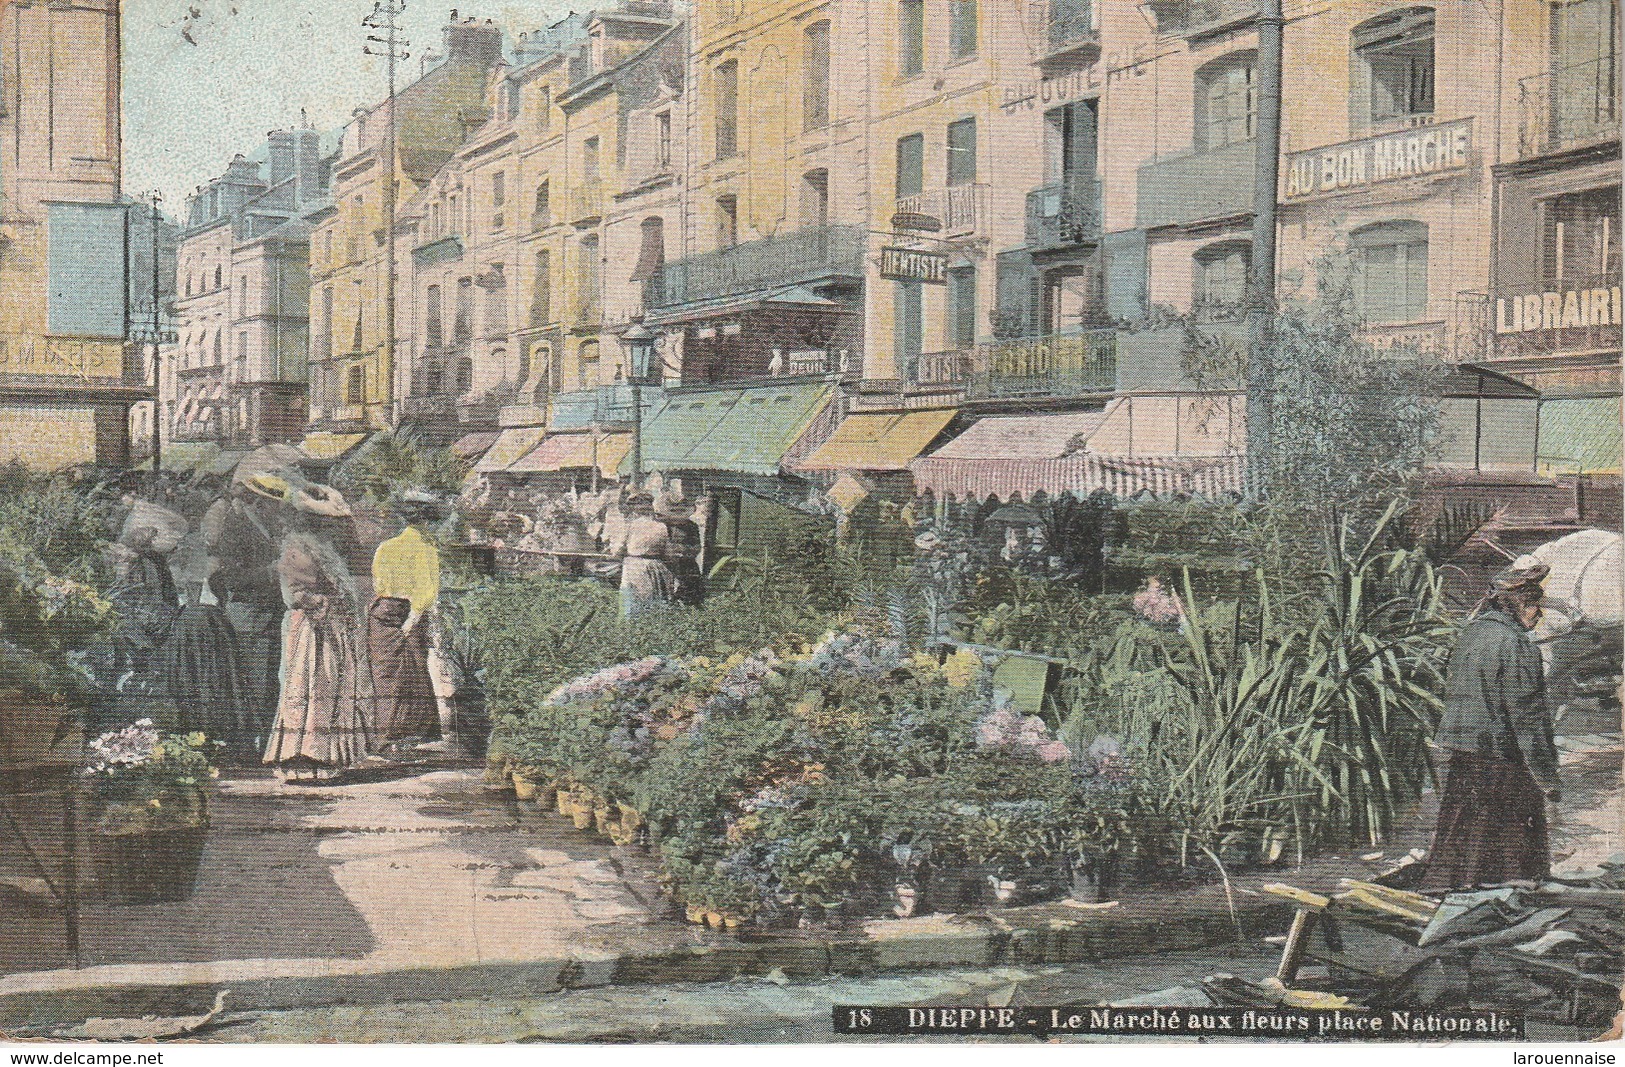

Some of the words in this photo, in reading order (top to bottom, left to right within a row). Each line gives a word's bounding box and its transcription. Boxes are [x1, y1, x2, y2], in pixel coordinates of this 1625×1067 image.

[1286, 157, 1314, 196] AU
[1321, 149, 1366, 190] BON
[789, 361, 826, 376] DEUIL
